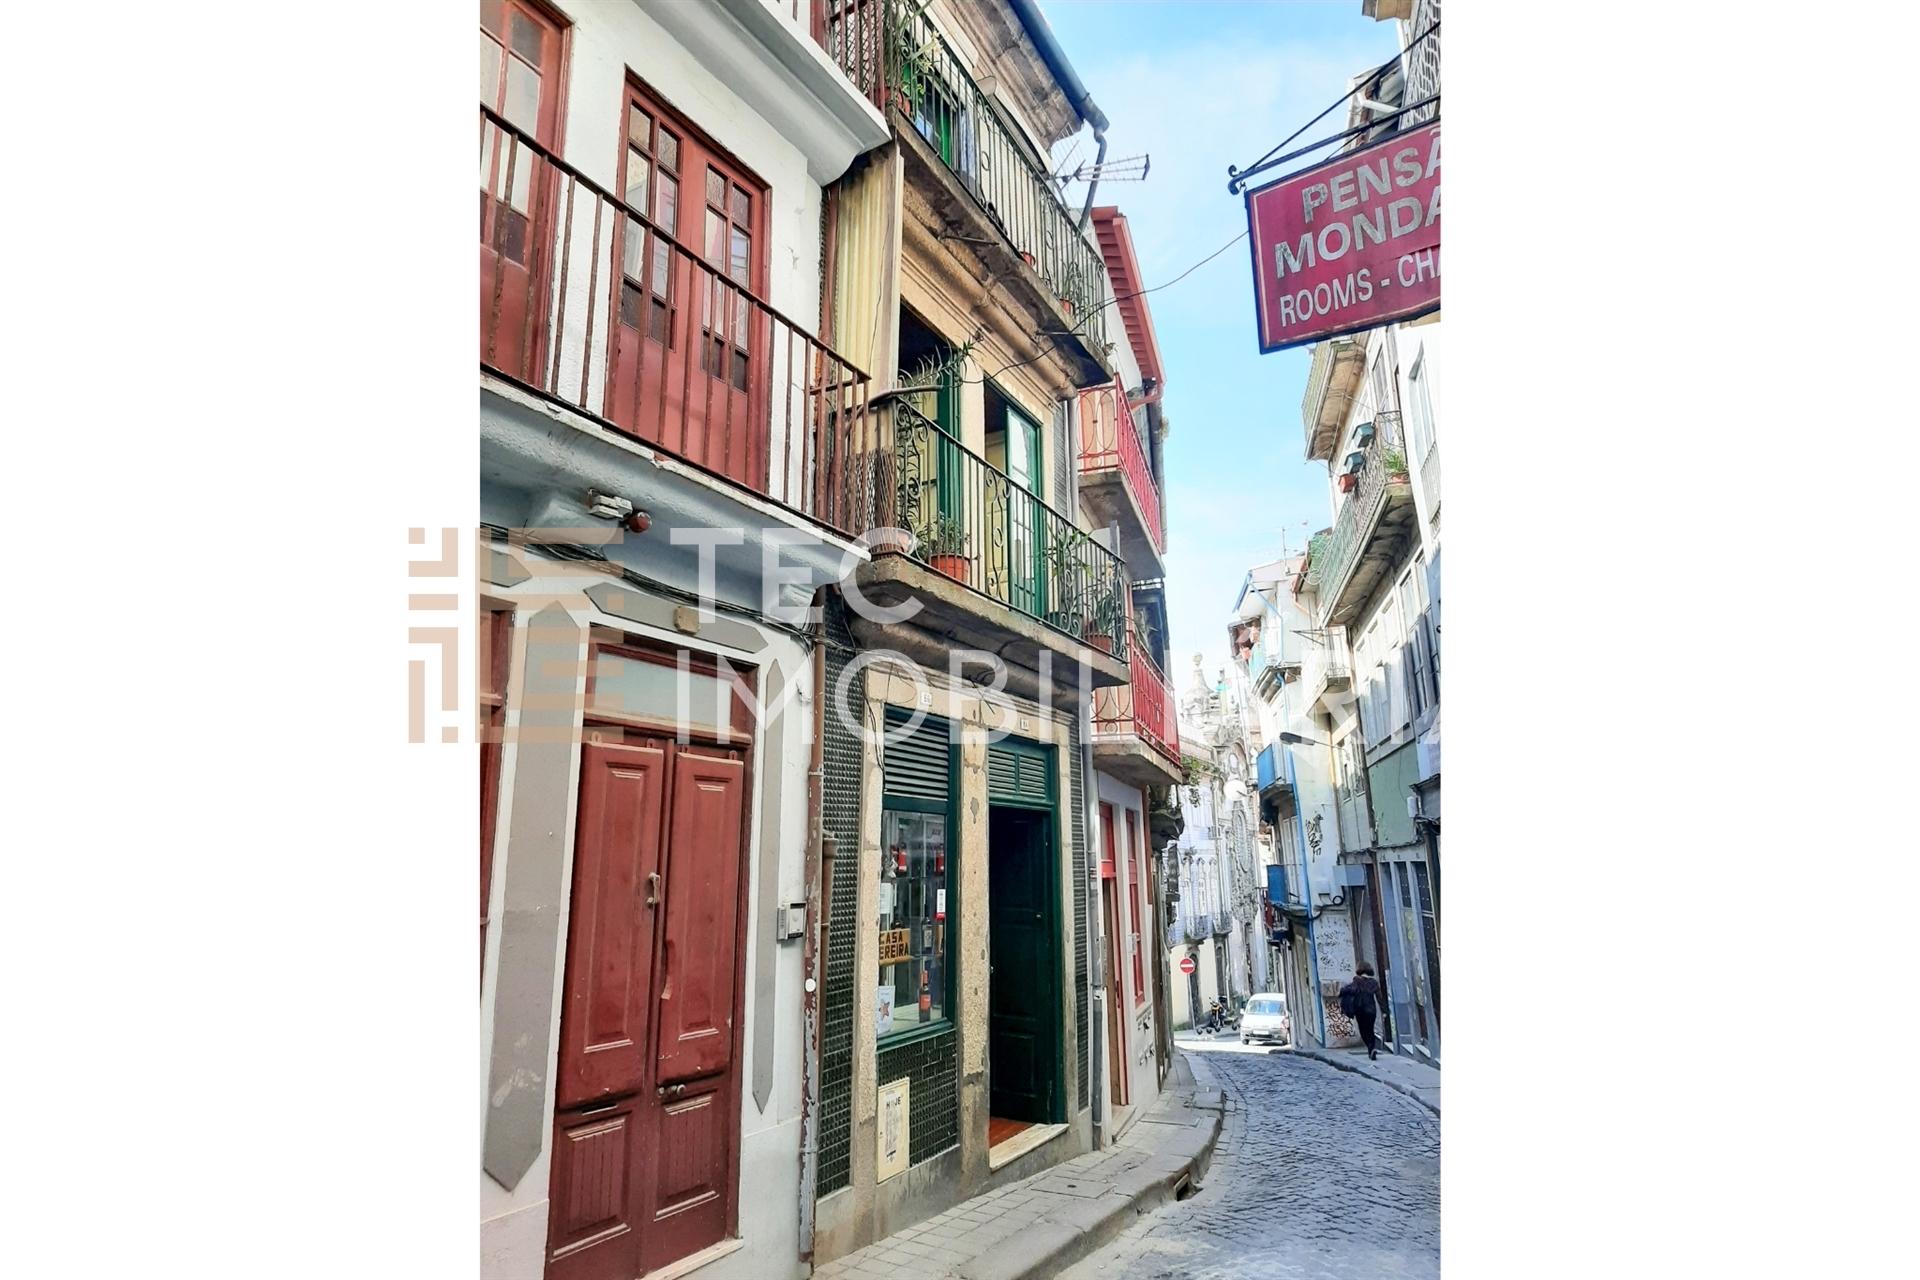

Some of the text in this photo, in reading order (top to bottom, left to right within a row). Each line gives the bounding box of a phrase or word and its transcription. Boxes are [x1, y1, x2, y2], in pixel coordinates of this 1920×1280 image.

[1279, 268, 1373, 327] ROOMS
[1397, 248, 1441, 288] CH
[879, 930, 903, 945] CASA
[879, 942, 909, 960] EREIRA
